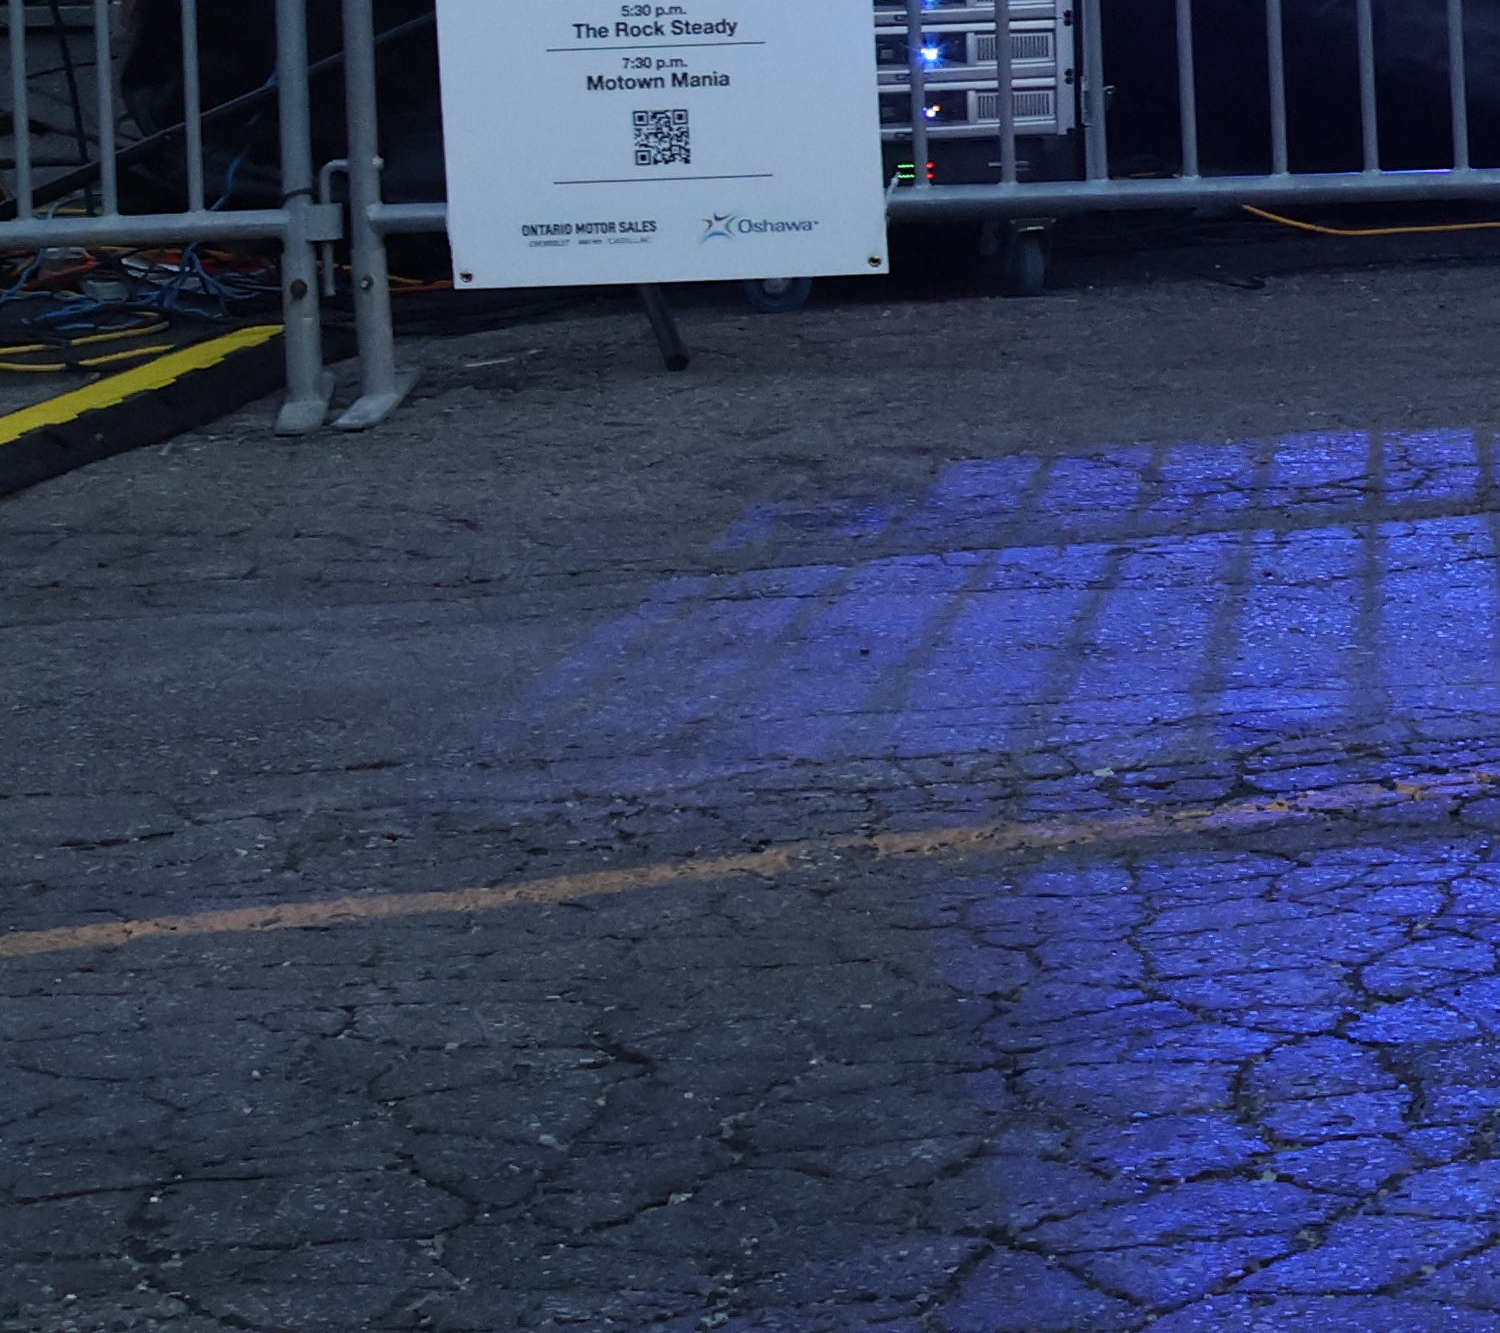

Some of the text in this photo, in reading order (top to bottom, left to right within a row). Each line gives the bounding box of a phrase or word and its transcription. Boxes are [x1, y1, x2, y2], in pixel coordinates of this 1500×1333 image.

[621, 4, 687, 18] 5:30 p.m.
[572, 18, 738, 39] The Rock Steady
[622, 57, 688, 71] 7:30 p.m.
[586, 70, 731, 91] Motown Mania
[521, 220, 658, 236] ONTARIO MOTOR SALES
[737, 217, 813, 235] Oshawa
